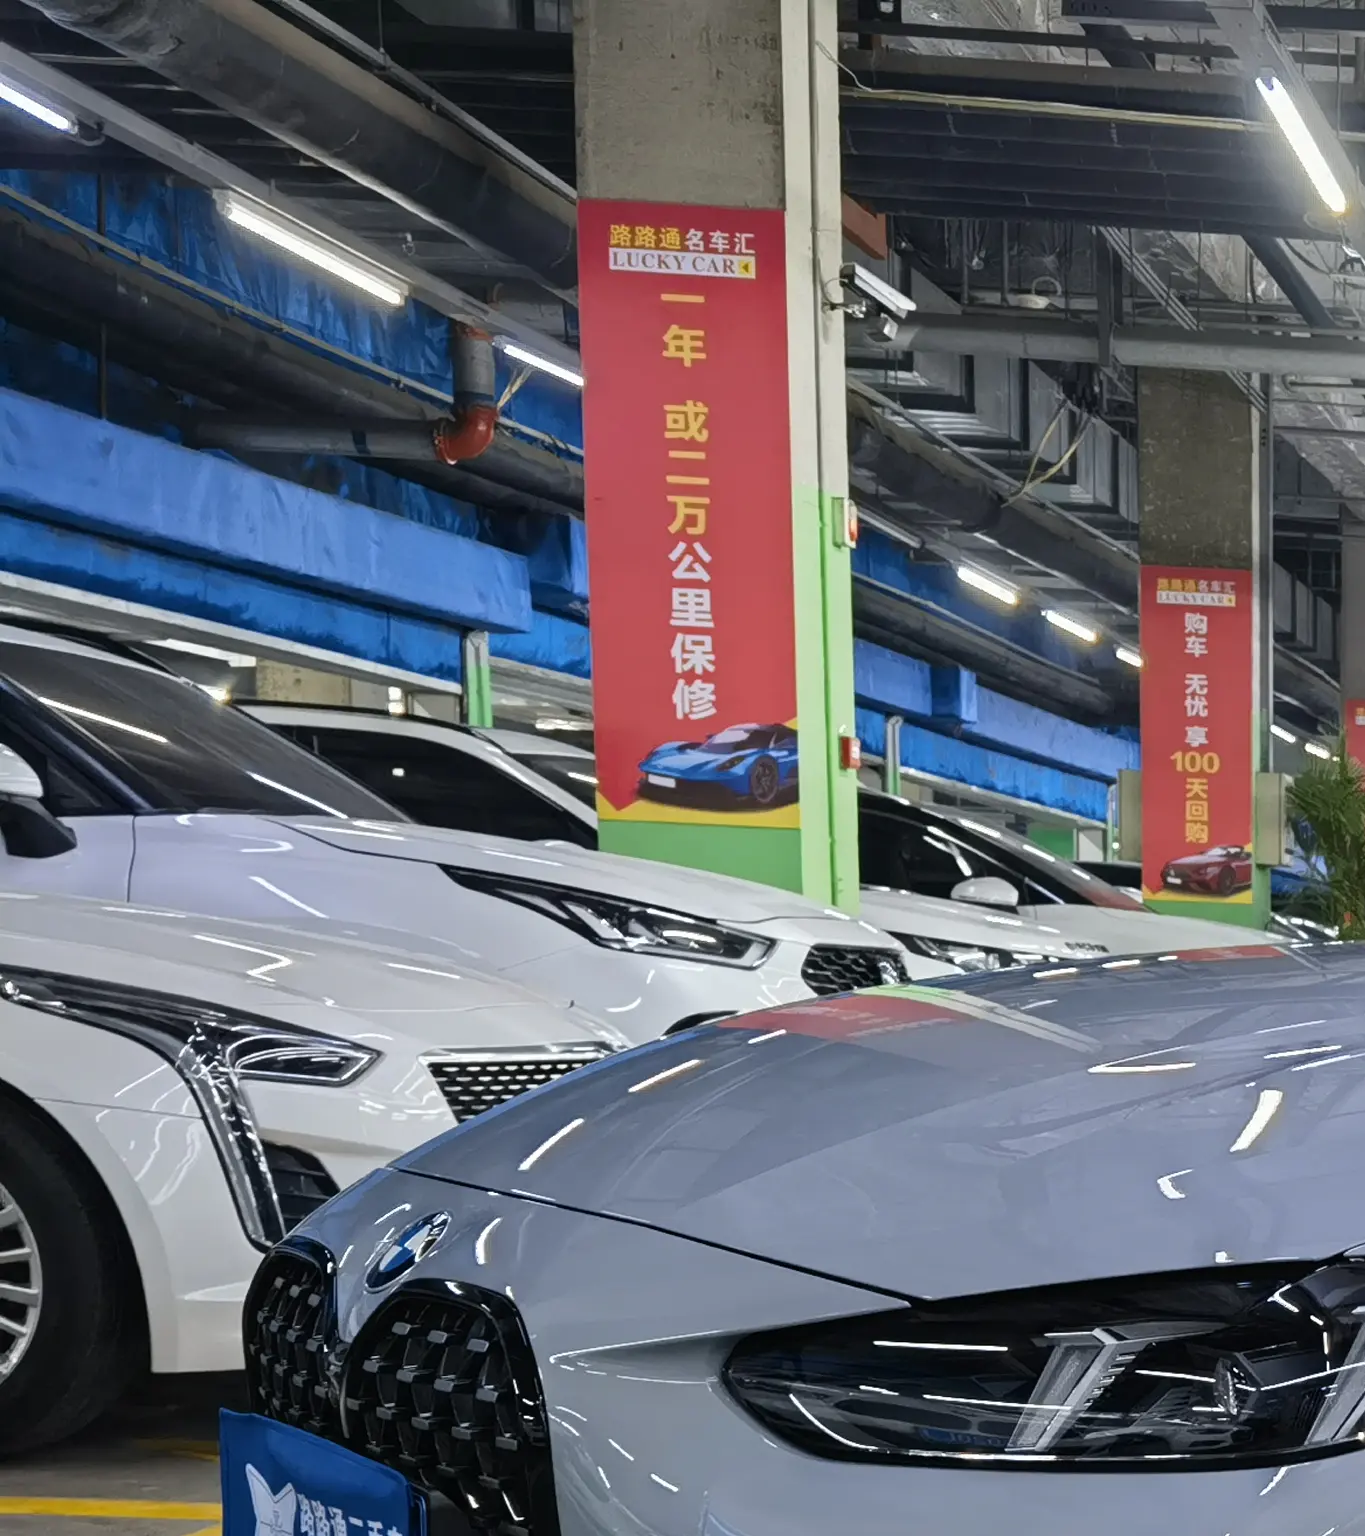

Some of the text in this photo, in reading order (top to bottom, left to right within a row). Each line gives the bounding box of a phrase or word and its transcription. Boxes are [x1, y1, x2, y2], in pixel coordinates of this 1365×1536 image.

[610, 224, 756, 254] 路路通名车汇
[612, 251, 736, 274] LUCKY CAR
